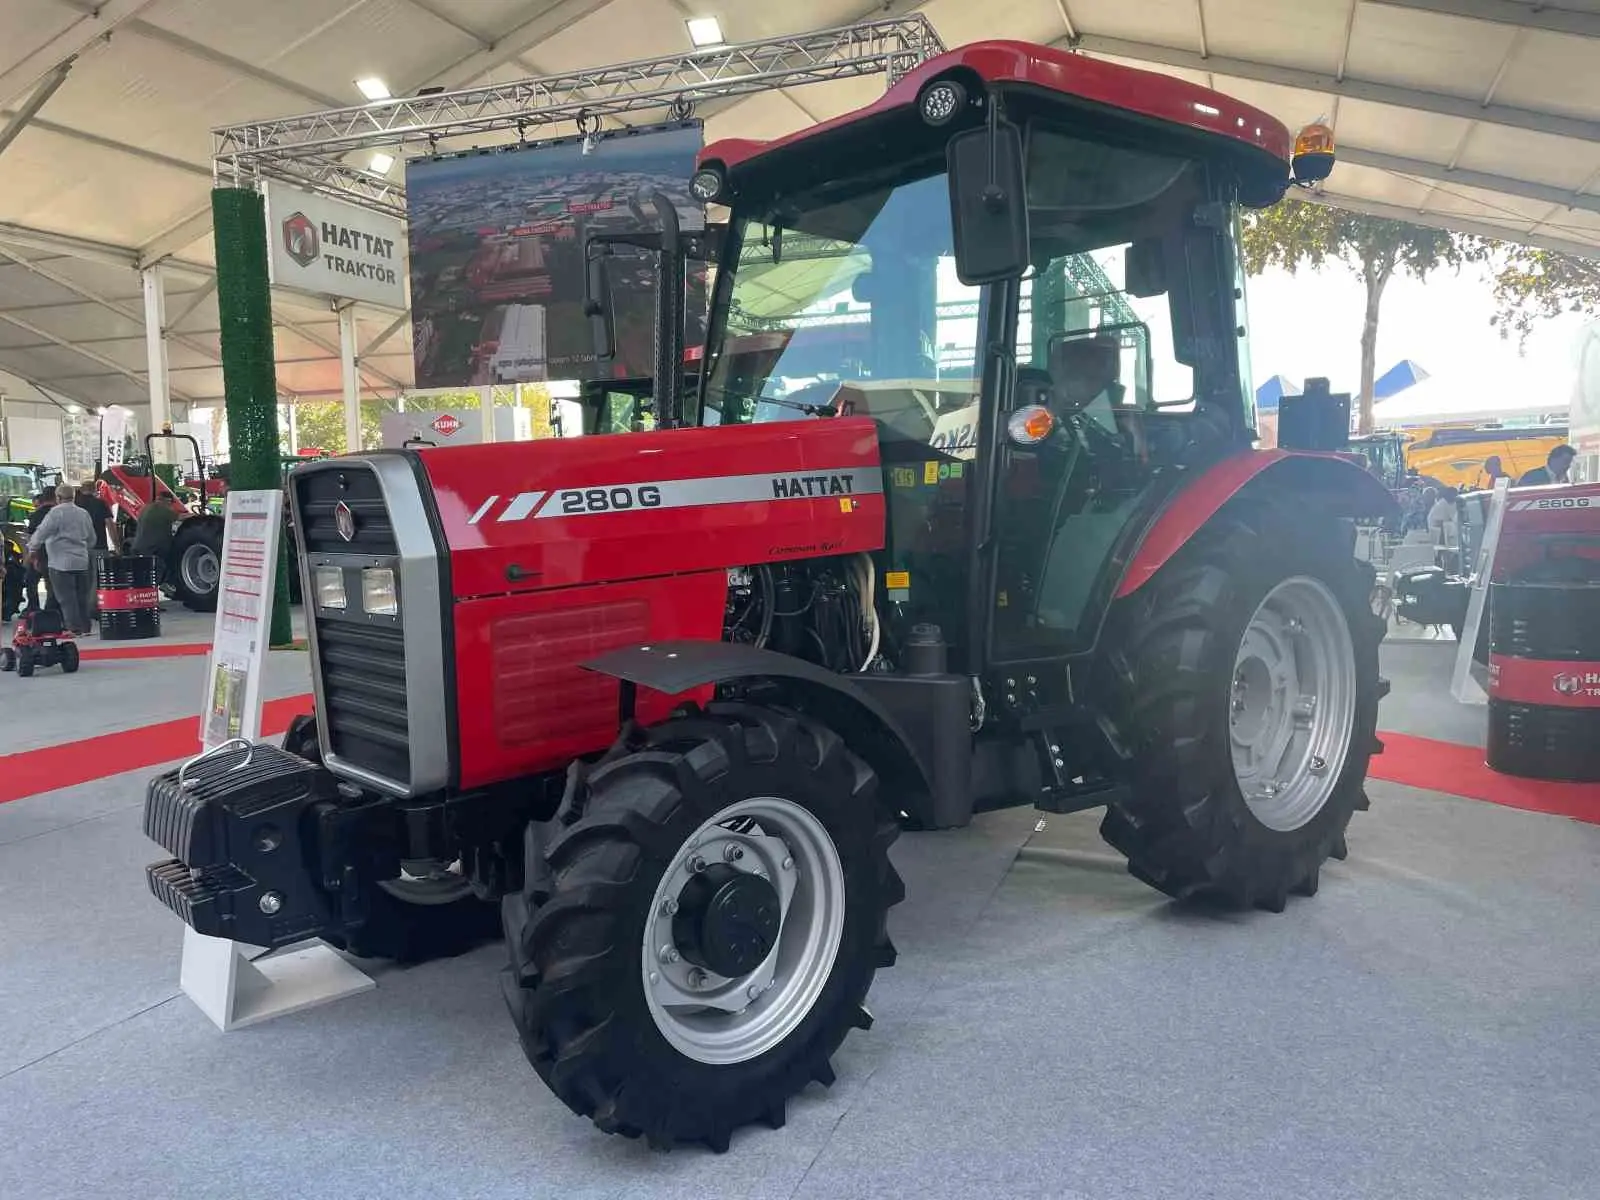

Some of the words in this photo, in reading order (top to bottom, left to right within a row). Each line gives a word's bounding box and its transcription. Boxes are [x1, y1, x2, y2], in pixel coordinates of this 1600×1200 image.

[321, 222, 394, 259] HATTAT
[323, 254, 396, 284] TRAKTÖR
[434, 420, 460, 430] KUHN
[772, 475, 854, 498] HATTAT
